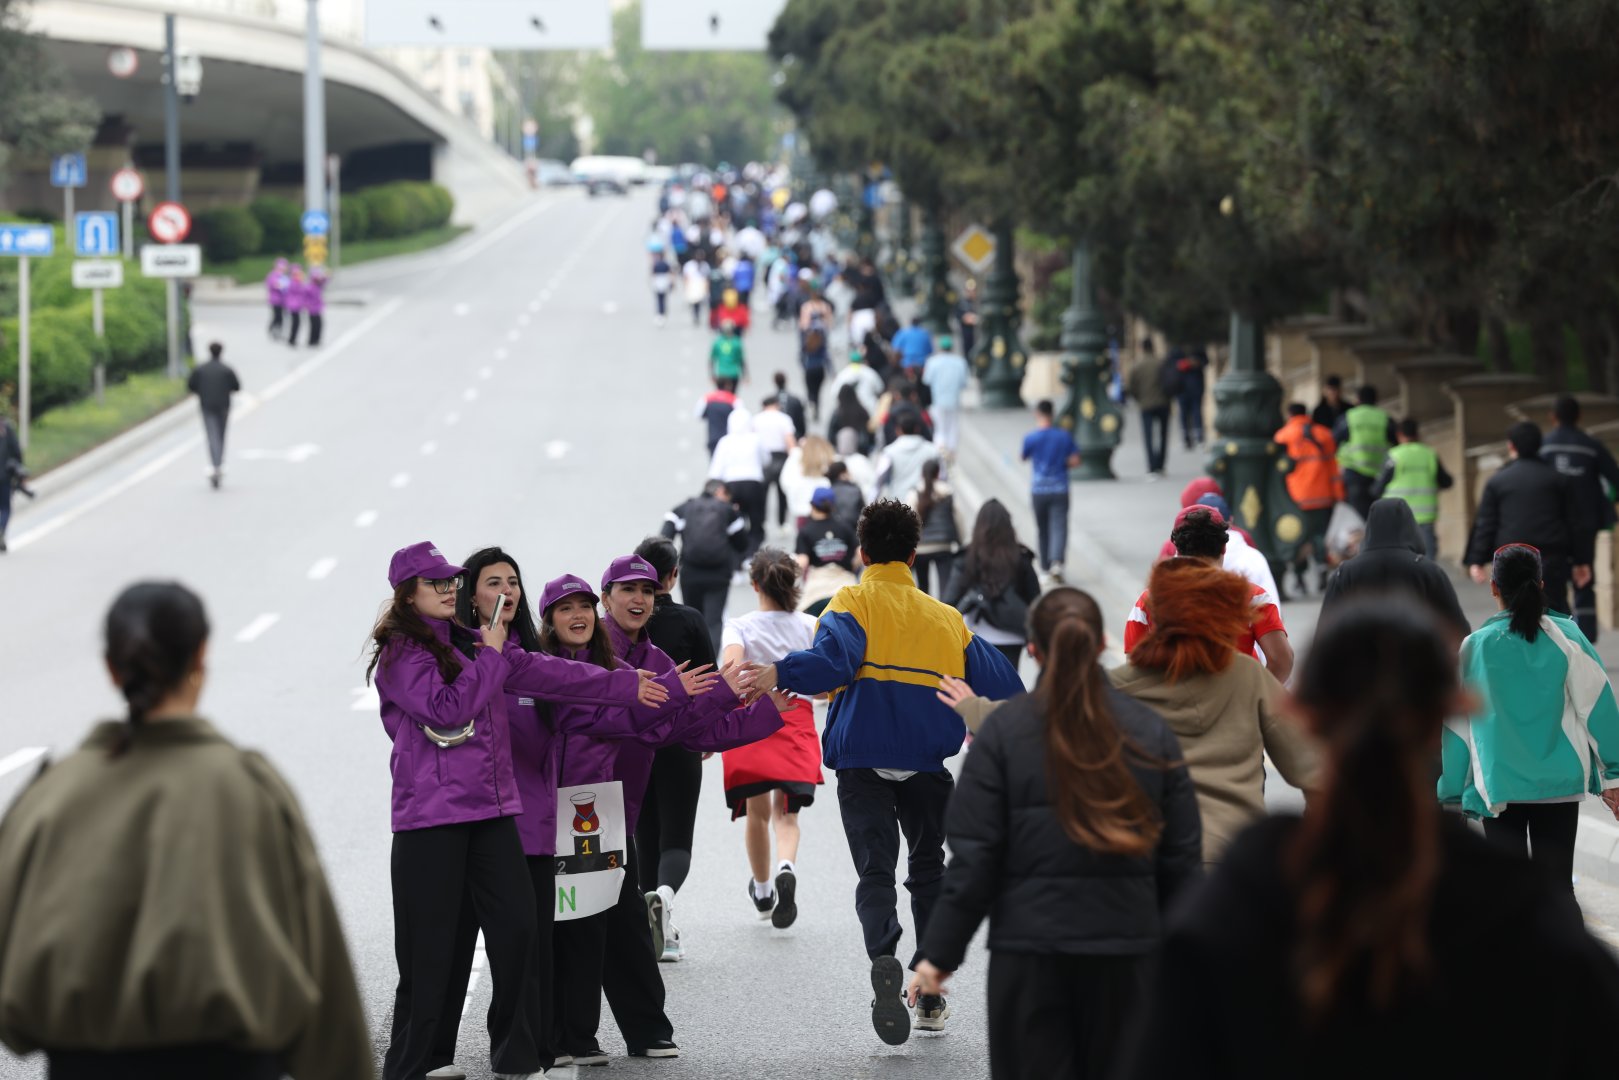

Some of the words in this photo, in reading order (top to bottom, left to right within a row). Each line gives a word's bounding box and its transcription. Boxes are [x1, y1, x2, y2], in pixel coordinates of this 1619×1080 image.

[581, 839, 593, 855] 1
[557, 860, 567, 875] 2
[607, 854, 618, 870] 3
[558, 886, 576, 913] N
